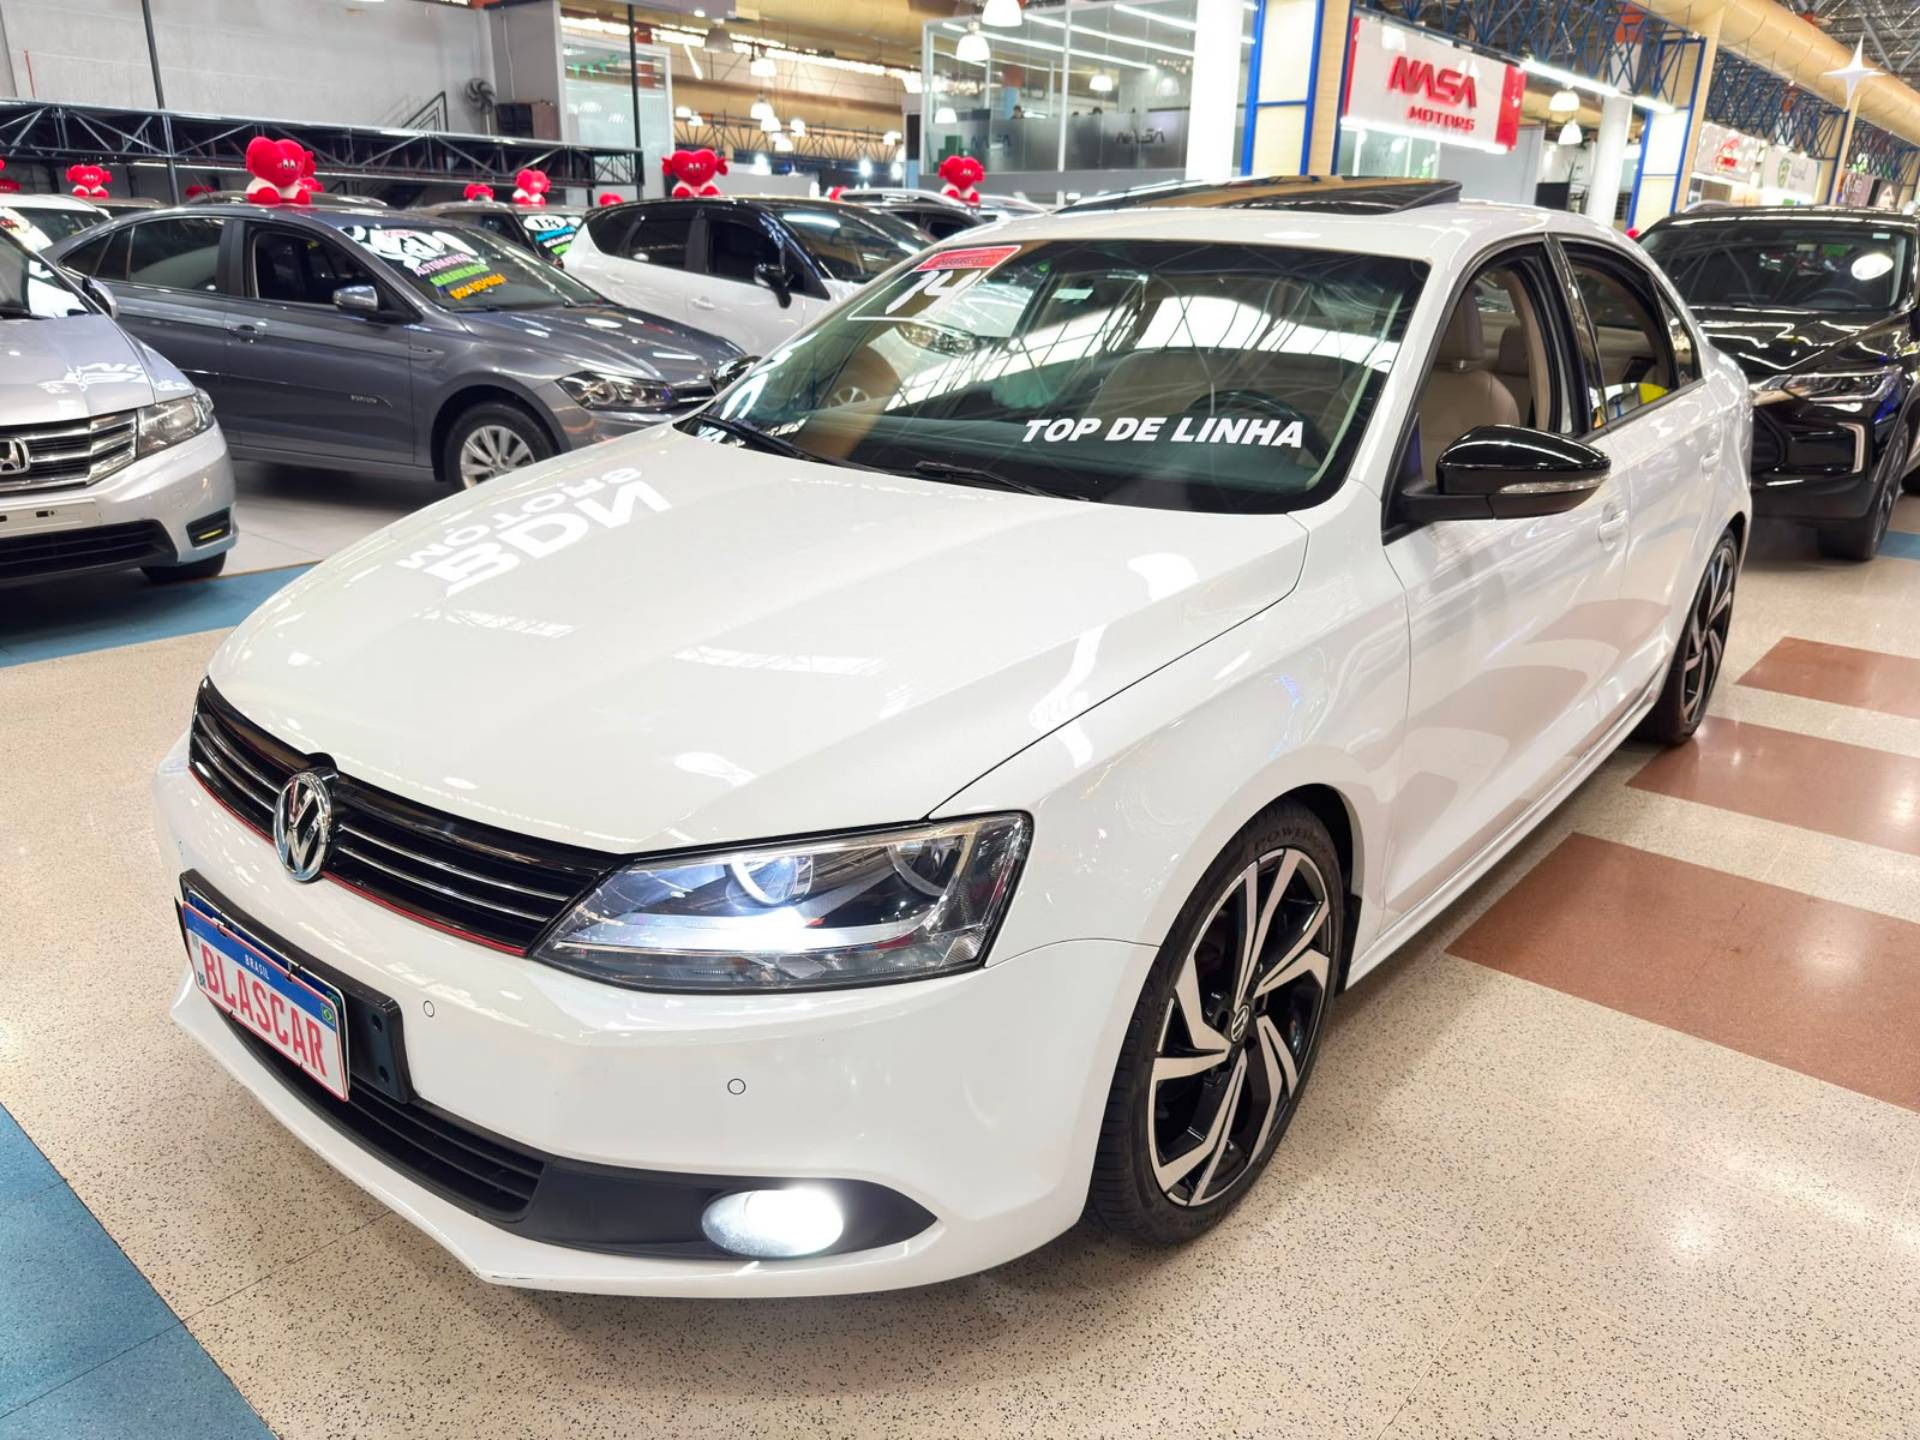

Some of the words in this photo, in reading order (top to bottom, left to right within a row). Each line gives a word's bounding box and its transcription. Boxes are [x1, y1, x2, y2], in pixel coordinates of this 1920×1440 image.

[1388, 55, 1478, 109] NASA
[1408, 105, 1476, 132] MOTORS
[1022, 418, 1102, 442] TOP
[1104, 417, 1167, 442] DE
[1170, 417, 1304, 448] LINHA
[244, 953, 270, 980] BRASIL
[201, 942, 328, 1078] BLASCAR
